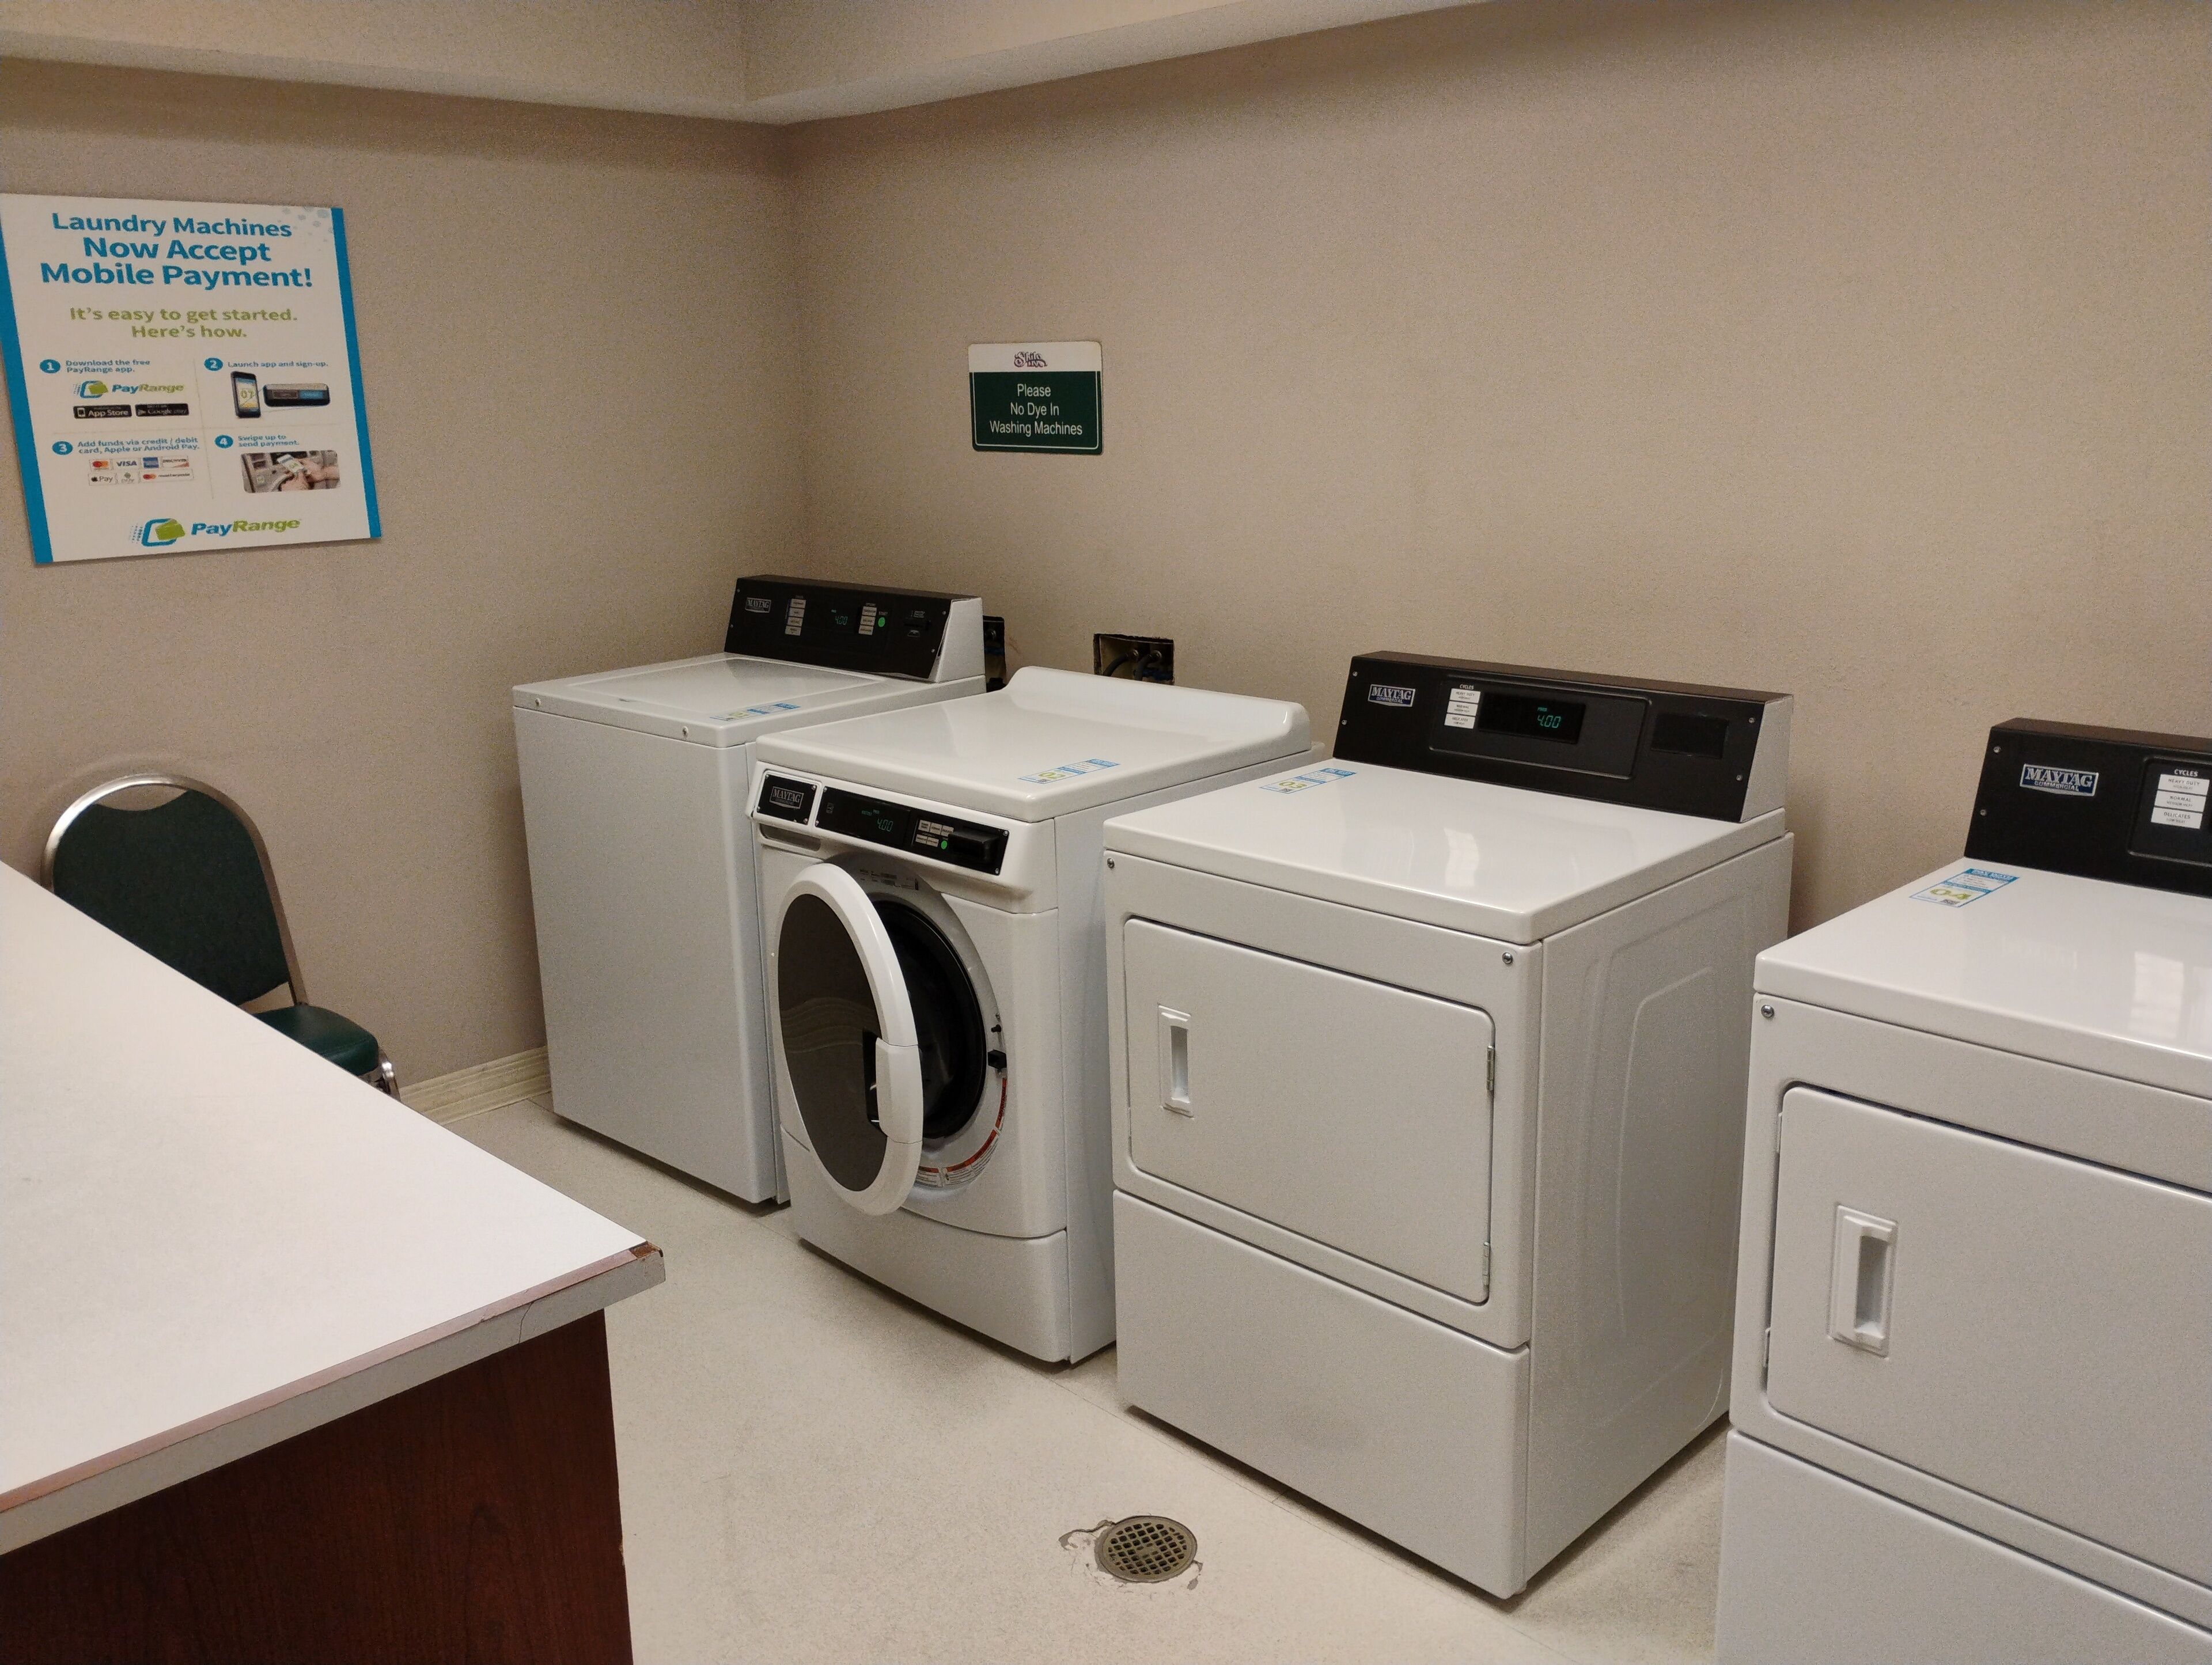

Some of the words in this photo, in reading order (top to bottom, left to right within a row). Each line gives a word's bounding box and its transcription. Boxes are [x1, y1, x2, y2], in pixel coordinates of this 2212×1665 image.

[52, 213, 166, 236] Laundry
[175, 217, 292, 237] Machines
[83, 237, 158, 259] Now
[167, 240, 272, 265] Accept
[40, 262, 154, 285] Mobile
[162, 266, 312, 290] Payment!
[70, 307, 103, 320] It's
[108, 310, 154, 323] easy
[161, 309, 181, 320] to
[187, 310, 218, 324] get
[222, 309, 298, 321] started.
[131, 325, 195, 338] Here's
[200, 326, 247, 338] how.
[47, 362, 54, 370] 1
[210, 361, 218, 369] 2
[112, 384, 184, 394] PayRange
[1017, 384, 1051, 397] Please
[1010, 403, 1024, 415] No
[1028, 403, 1047, 419] Dye
[1050, 404, 1059, 416] In
[990, 420, 1031, 437] Washing
[1035, 421, 1082, 435] Machines
[59, 444, 67, 452] 3
[191, 519, 300, 536] PayRange
[747, 599, 770, 608] MAYTAG
[1372, 687, 1411, 700] MAYTAG
[2025, 768, 2093, 787] MAYTAG
[2174, 769, 2198, 777] CYCLES
[2034, 780, 2080, 791] COMMERCIAL
[772, 788, 801, 803] MAYTAG
